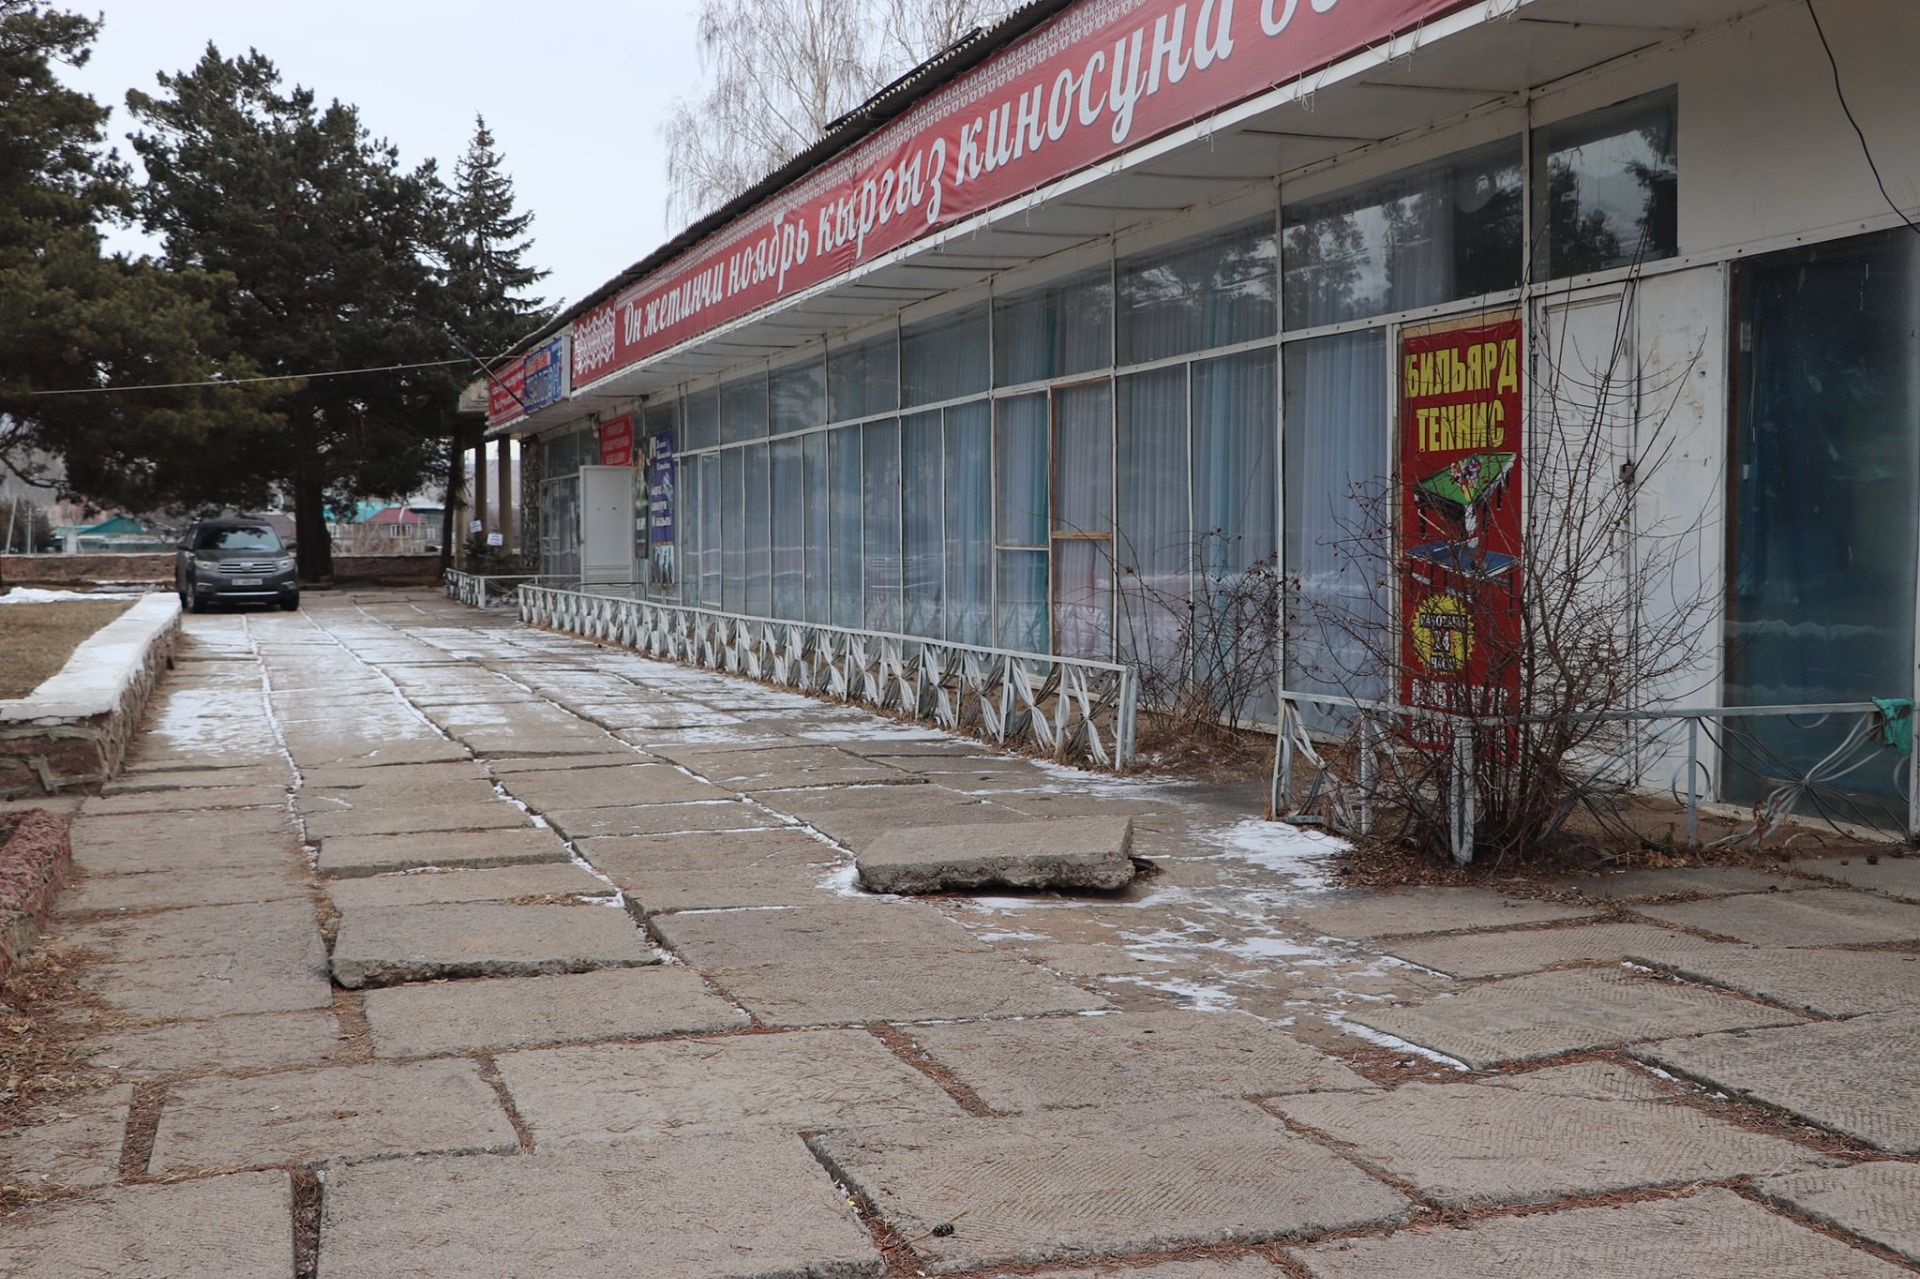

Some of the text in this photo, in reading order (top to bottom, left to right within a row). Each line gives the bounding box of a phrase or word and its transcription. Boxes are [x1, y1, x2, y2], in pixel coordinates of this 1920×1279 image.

[624, 301, 643, 346] Он
[643, 262, 725, 338] жетинчи
[727, 211, 810, 294] ноябрь
[816, 137, 946, 260] кыргыз
[955, 0, 1235, 187] киносуна
[1405, 338, 1518, 399] БИЛЬЯРД
[1416, 399, 1505, 453] ТЕННИС
